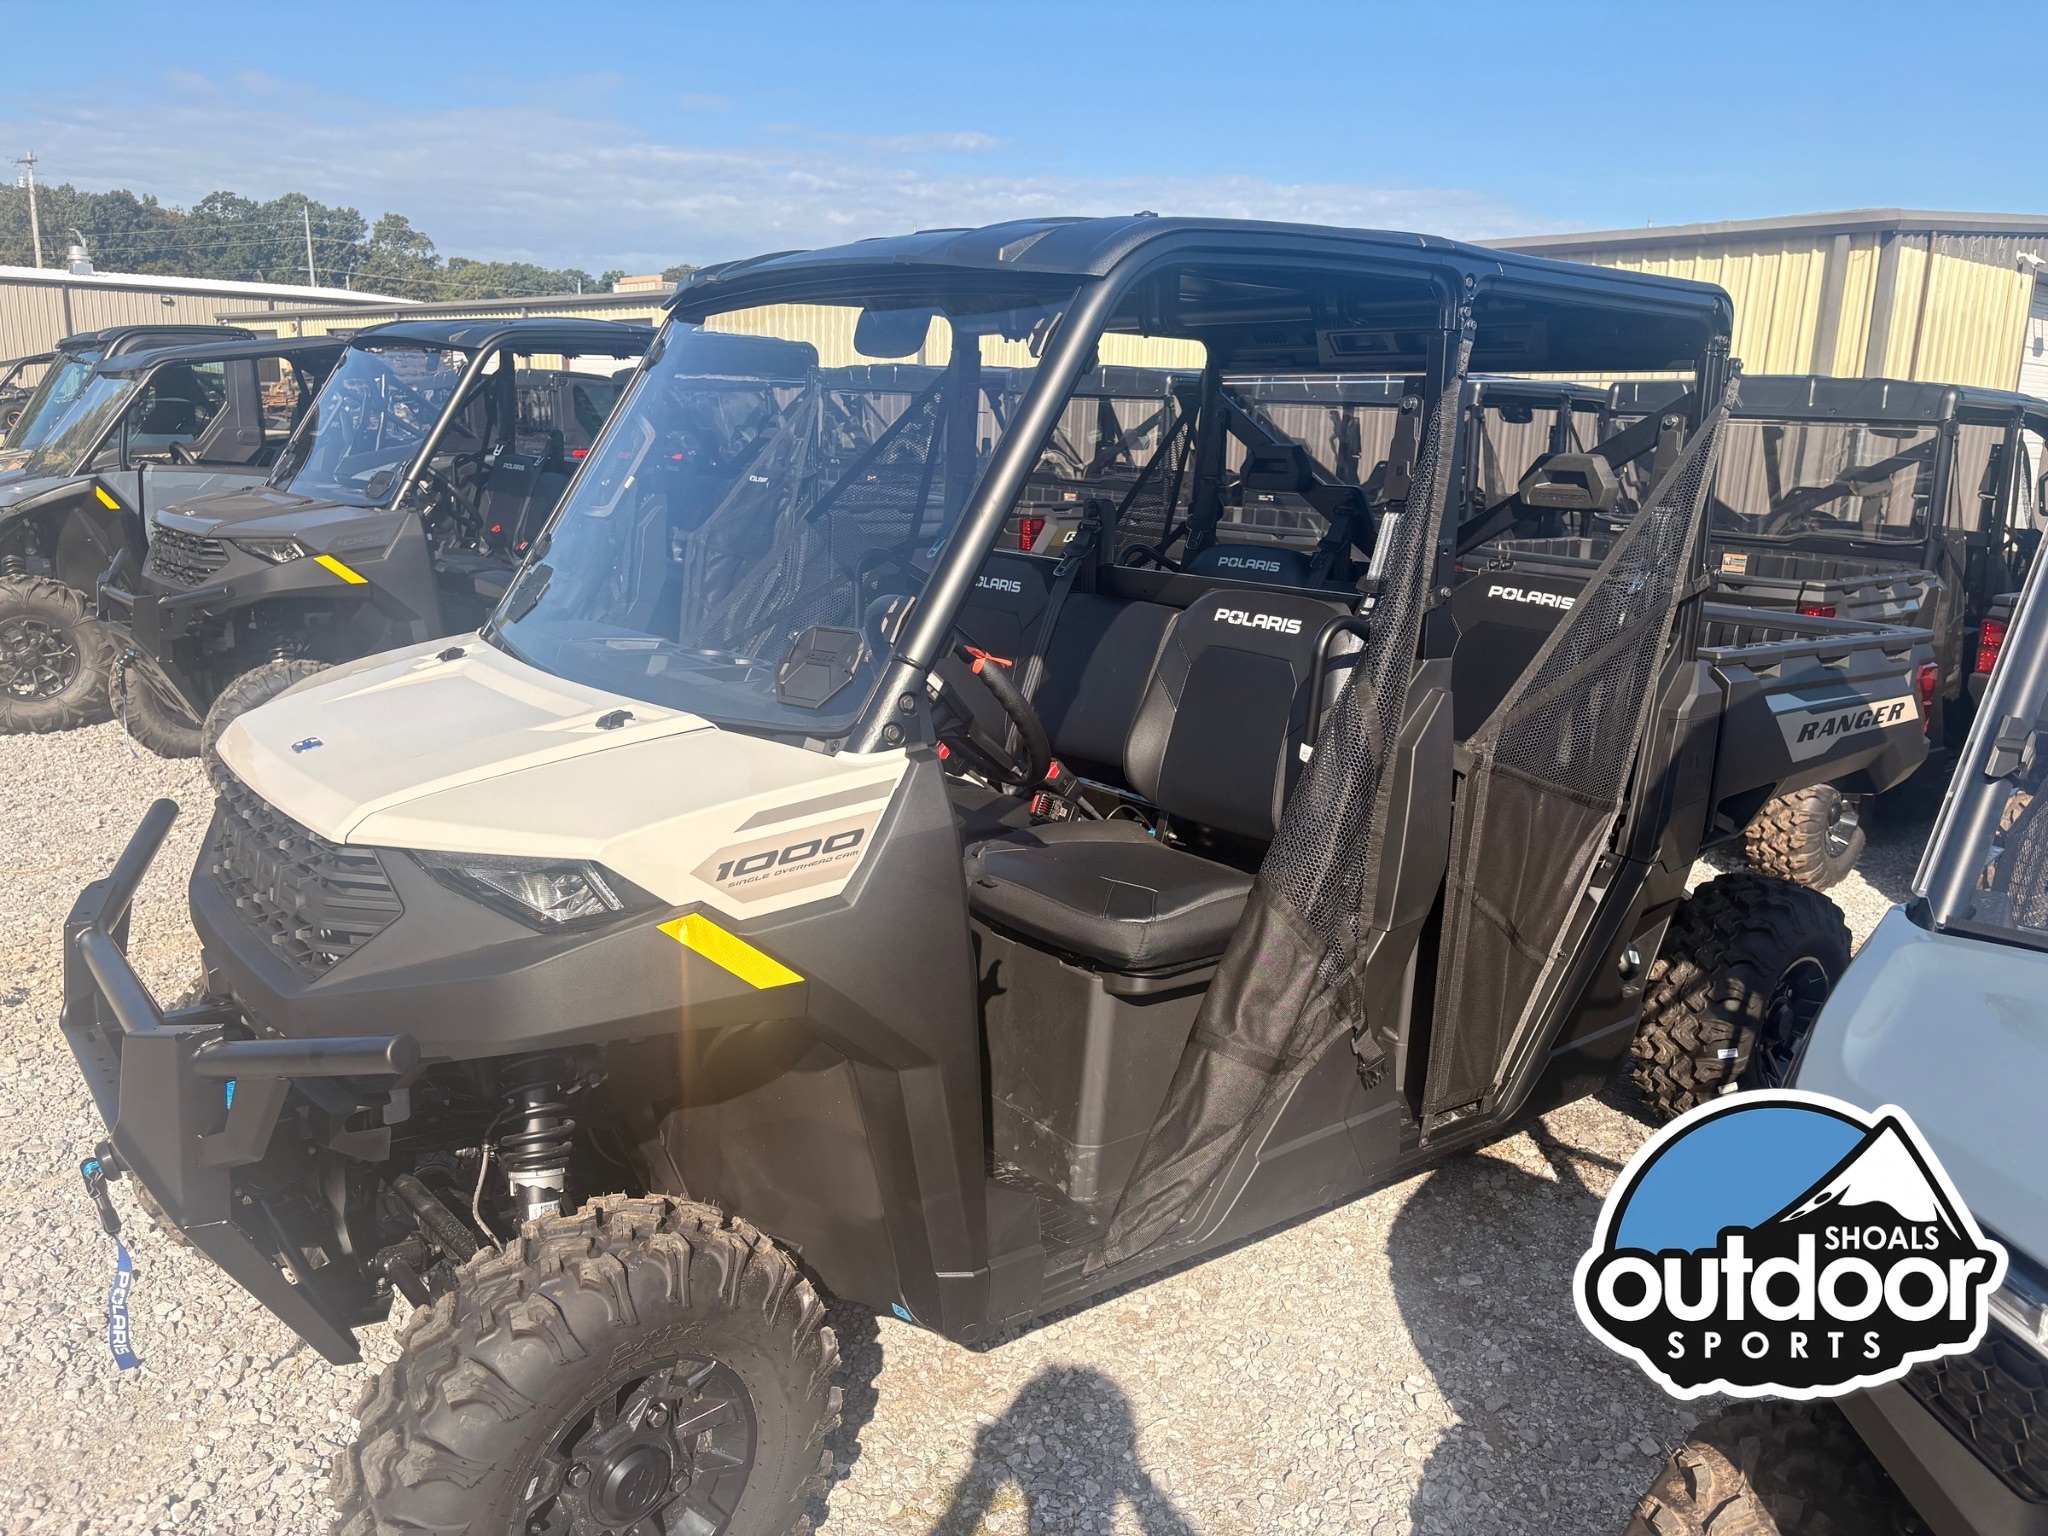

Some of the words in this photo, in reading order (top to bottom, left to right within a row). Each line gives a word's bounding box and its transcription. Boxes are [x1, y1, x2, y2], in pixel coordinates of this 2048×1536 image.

[503, 462, 525, 471] POLARIS
[1217, 556, 1281, 572] POLARIS
[975, 575, 1022, 593] OLARIS
[1487, 585, 1576, 610] POLARIS
[1213, 607, 1303, 635] POLARIS
[1796, 702, 1905, 743] RANGER
[715, 828, 865, 882] 1000
[727, 873, 771, 889] SINGLE
[774, 856, 833, 876] OVERHEAD
[835, 850, 860, 860] CAM
[111, 1270, 130, 1355] POLARIS
